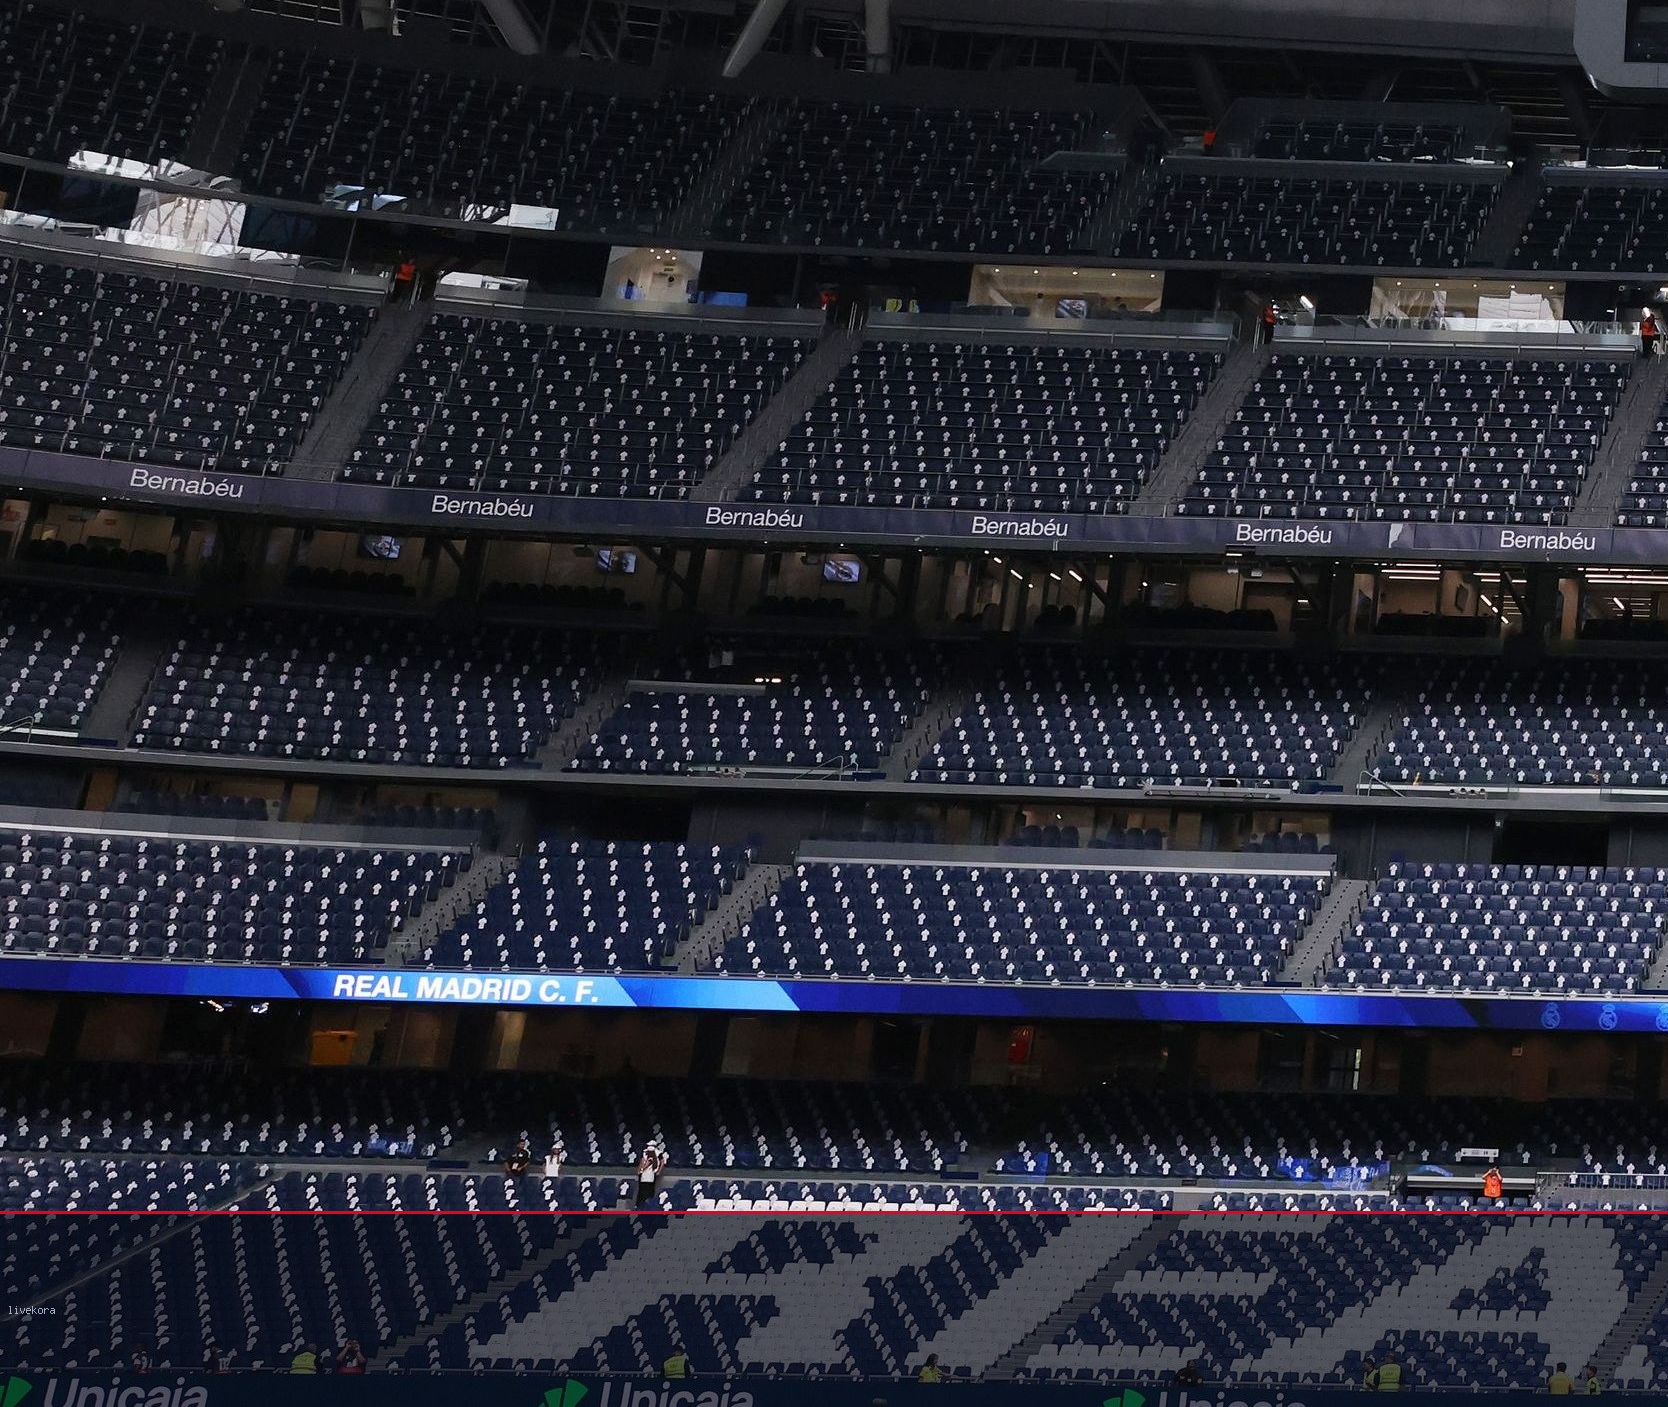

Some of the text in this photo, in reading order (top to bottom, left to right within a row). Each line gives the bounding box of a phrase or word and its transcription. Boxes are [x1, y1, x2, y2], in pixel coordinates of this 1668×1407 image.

[130, 467, 243, 500] Bernabéu
[432, 495, 533, 518] Bernabéu
[705, 507, 803, 528] Bernabéu
[972, 516, 1068, 537] Bernabéu
[1237, 523, 1332, 546] Bernabéu
[1500, 529, 1596, 551] Bernabéu
[334, 975, 598, 1004] REAL MADRID C. F.
